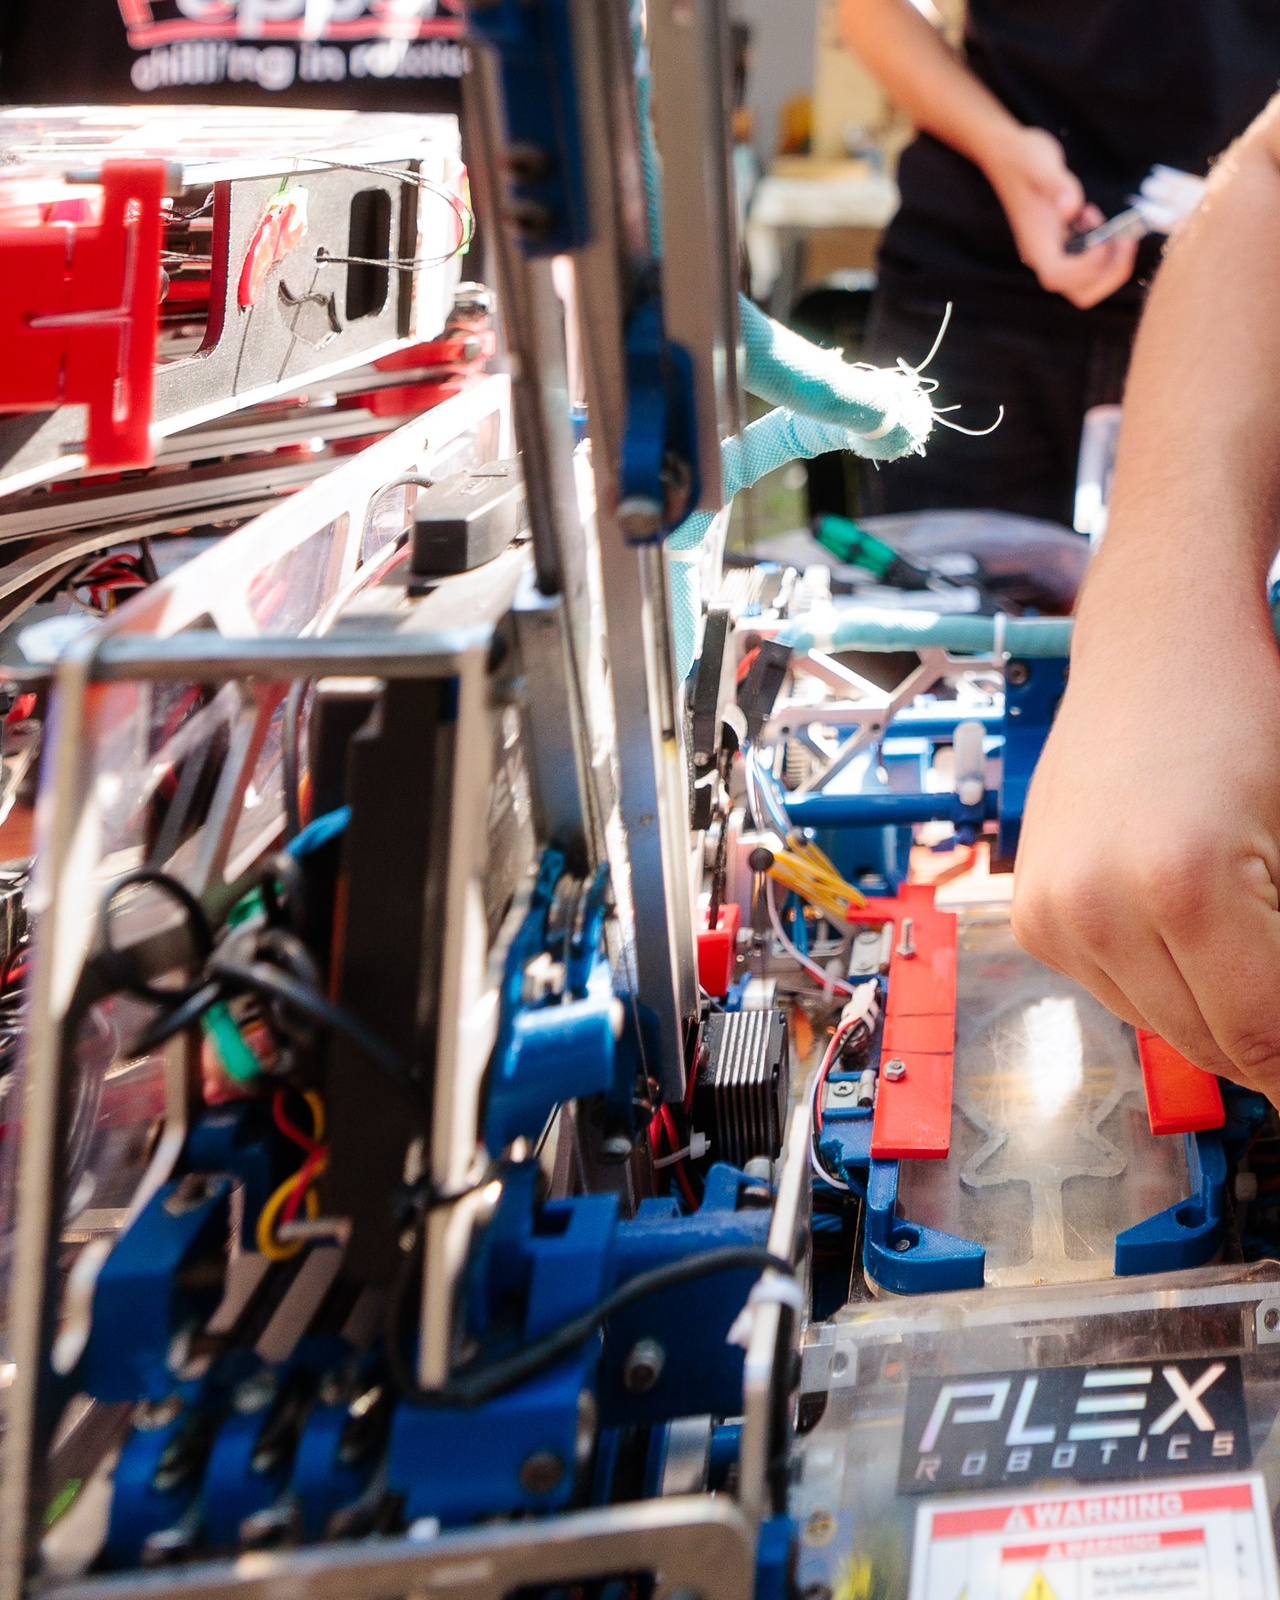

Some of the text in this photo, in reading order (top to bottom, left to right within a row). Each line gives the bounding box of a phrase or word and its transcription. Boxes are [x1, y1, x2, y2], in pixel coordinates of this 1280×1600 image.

[917, 1361, 1227, 1453] PLEX
[913, 1430, 1236, 1482] ROBOTICS
[1033, 1490, 1184, 1528] WARNING
